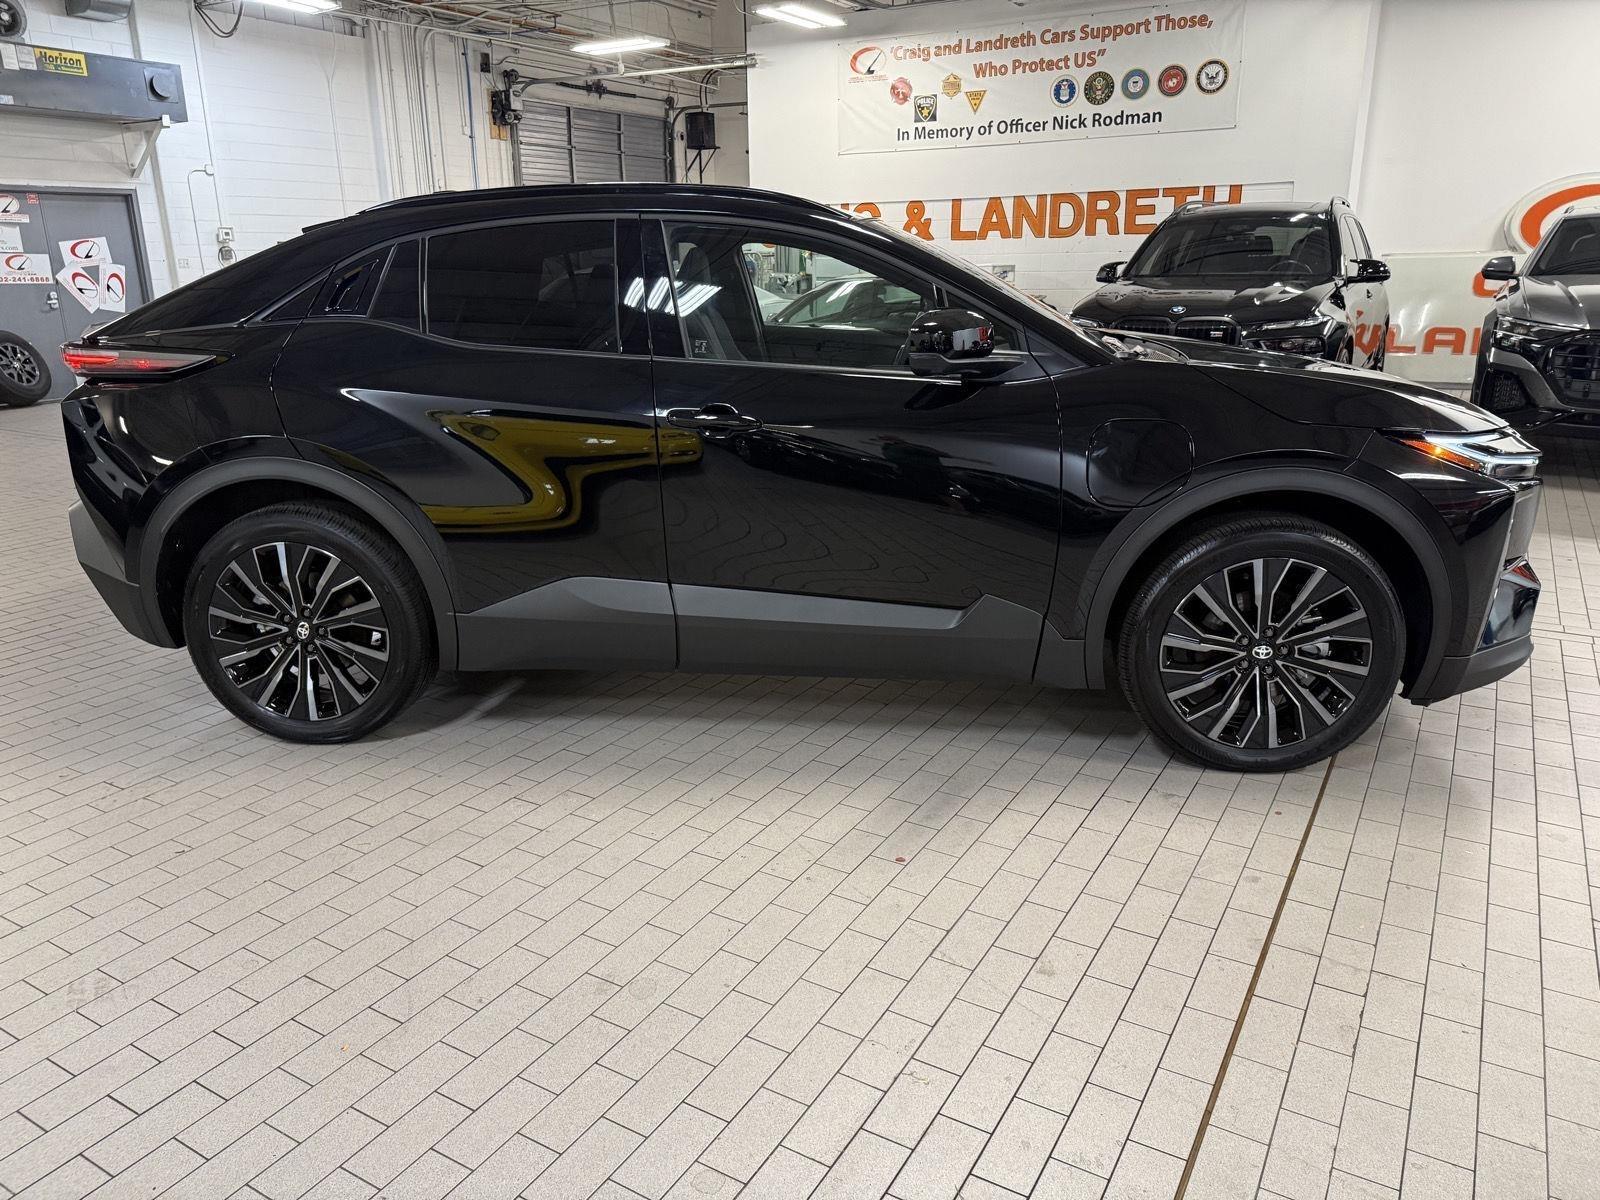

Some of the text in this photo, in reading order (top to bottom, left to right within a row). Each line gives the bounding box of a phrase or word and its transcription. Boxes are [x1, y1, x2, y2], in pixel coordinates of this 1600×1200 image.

[933, 39, 962, 57] and
[965, 31, 1037, 54] Landreth
[1040, 28, 1076, 45] Cars
[1079, 18, 1152, 43] Support
[1154, 13, 1214, 33] Those,
[39, 50, 82, 67] Horizon
[973, 61, 1009, 78] Who
[1011, 54, 1071, 75] Protect
[896, 110, 1163, 142] In Memory of Officer Nick Rodman
[903, 200, 935, 241] &
